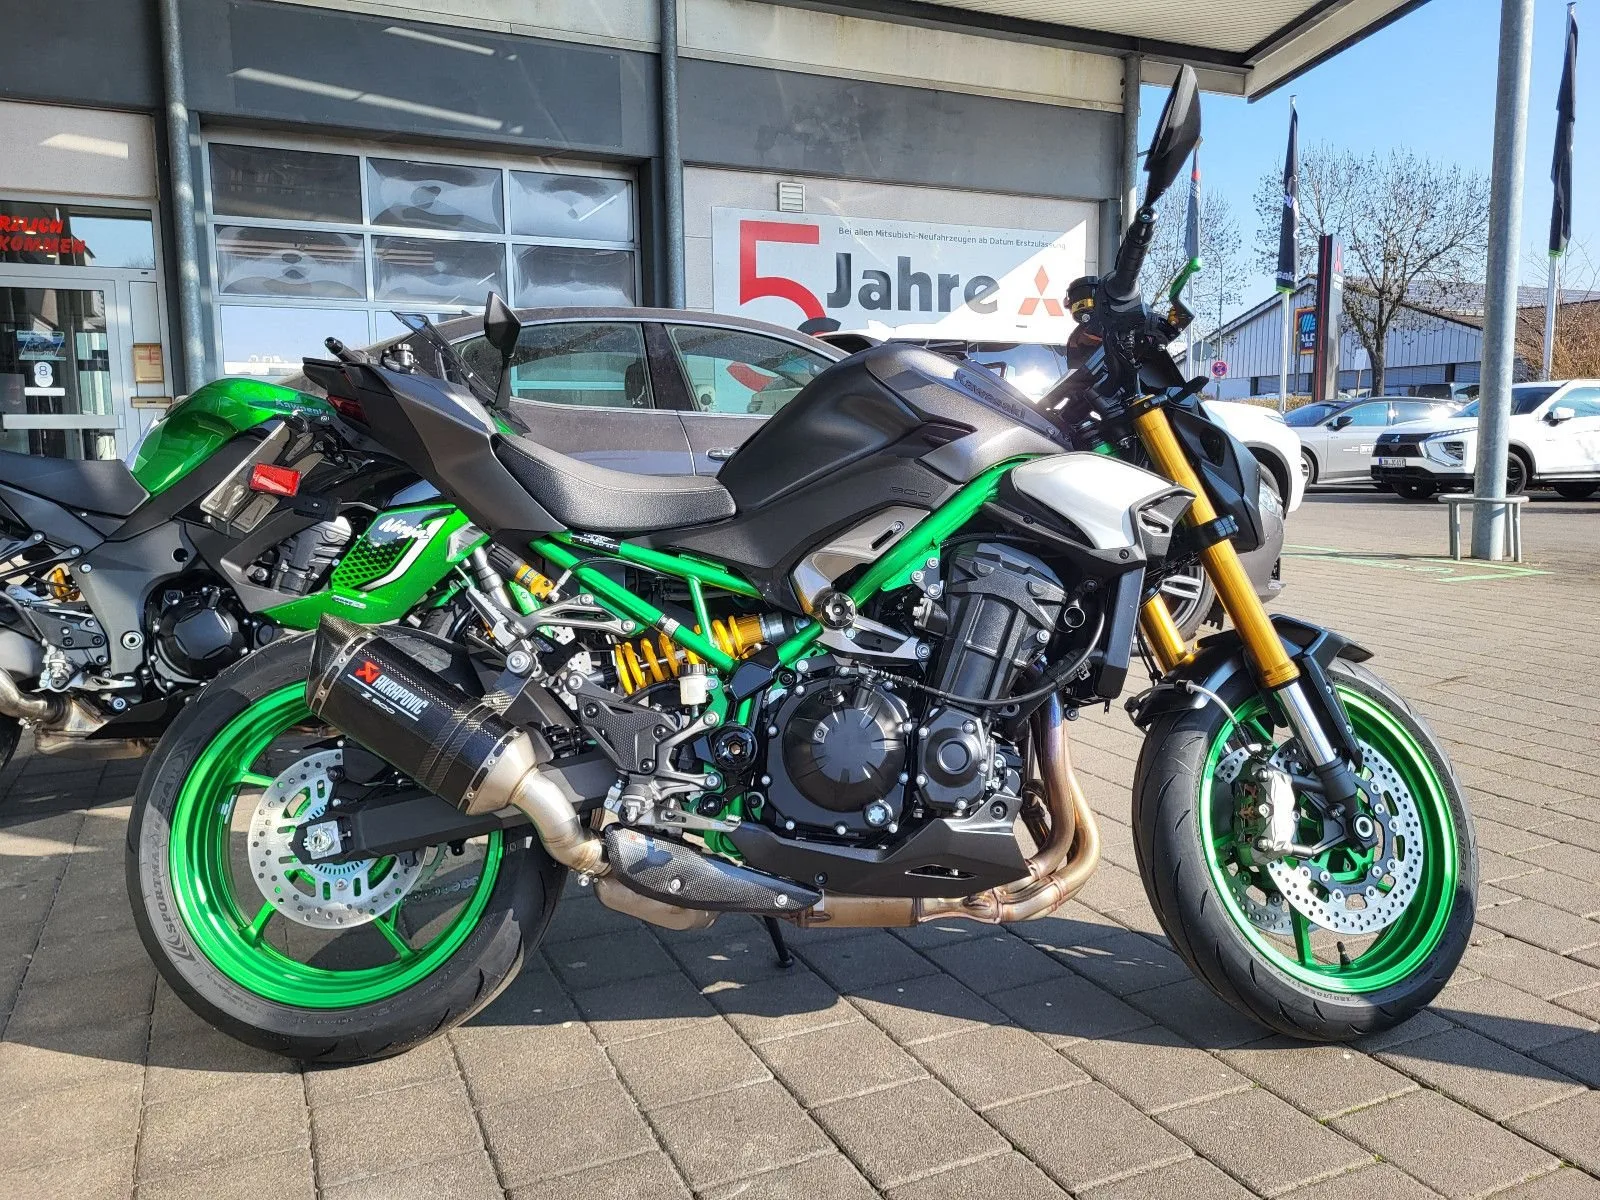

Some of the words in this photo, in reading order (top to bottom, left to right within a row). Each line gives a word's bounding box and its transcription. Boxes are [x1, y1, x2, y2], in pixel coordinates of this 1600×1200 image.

[838, 227, 852, 235] Bei
[854, 229, 874, 237] allen
[875, 229, 977, 244] Mitsubishi-Neufahrzeugen
[978, 236, 988, 244] ab
[989, 237, 1014, 246] Datum
[1016, 239, 1066, 250] Erstzulassung
[827, 252, 999, 314] Jahre
[955, 368, 1026, 420] Kawasaki
[891, 486, 931, 498] 900
[361, 690, 373, 701] Z
[372, 674, 430, 715] AKRAPOVIČ
